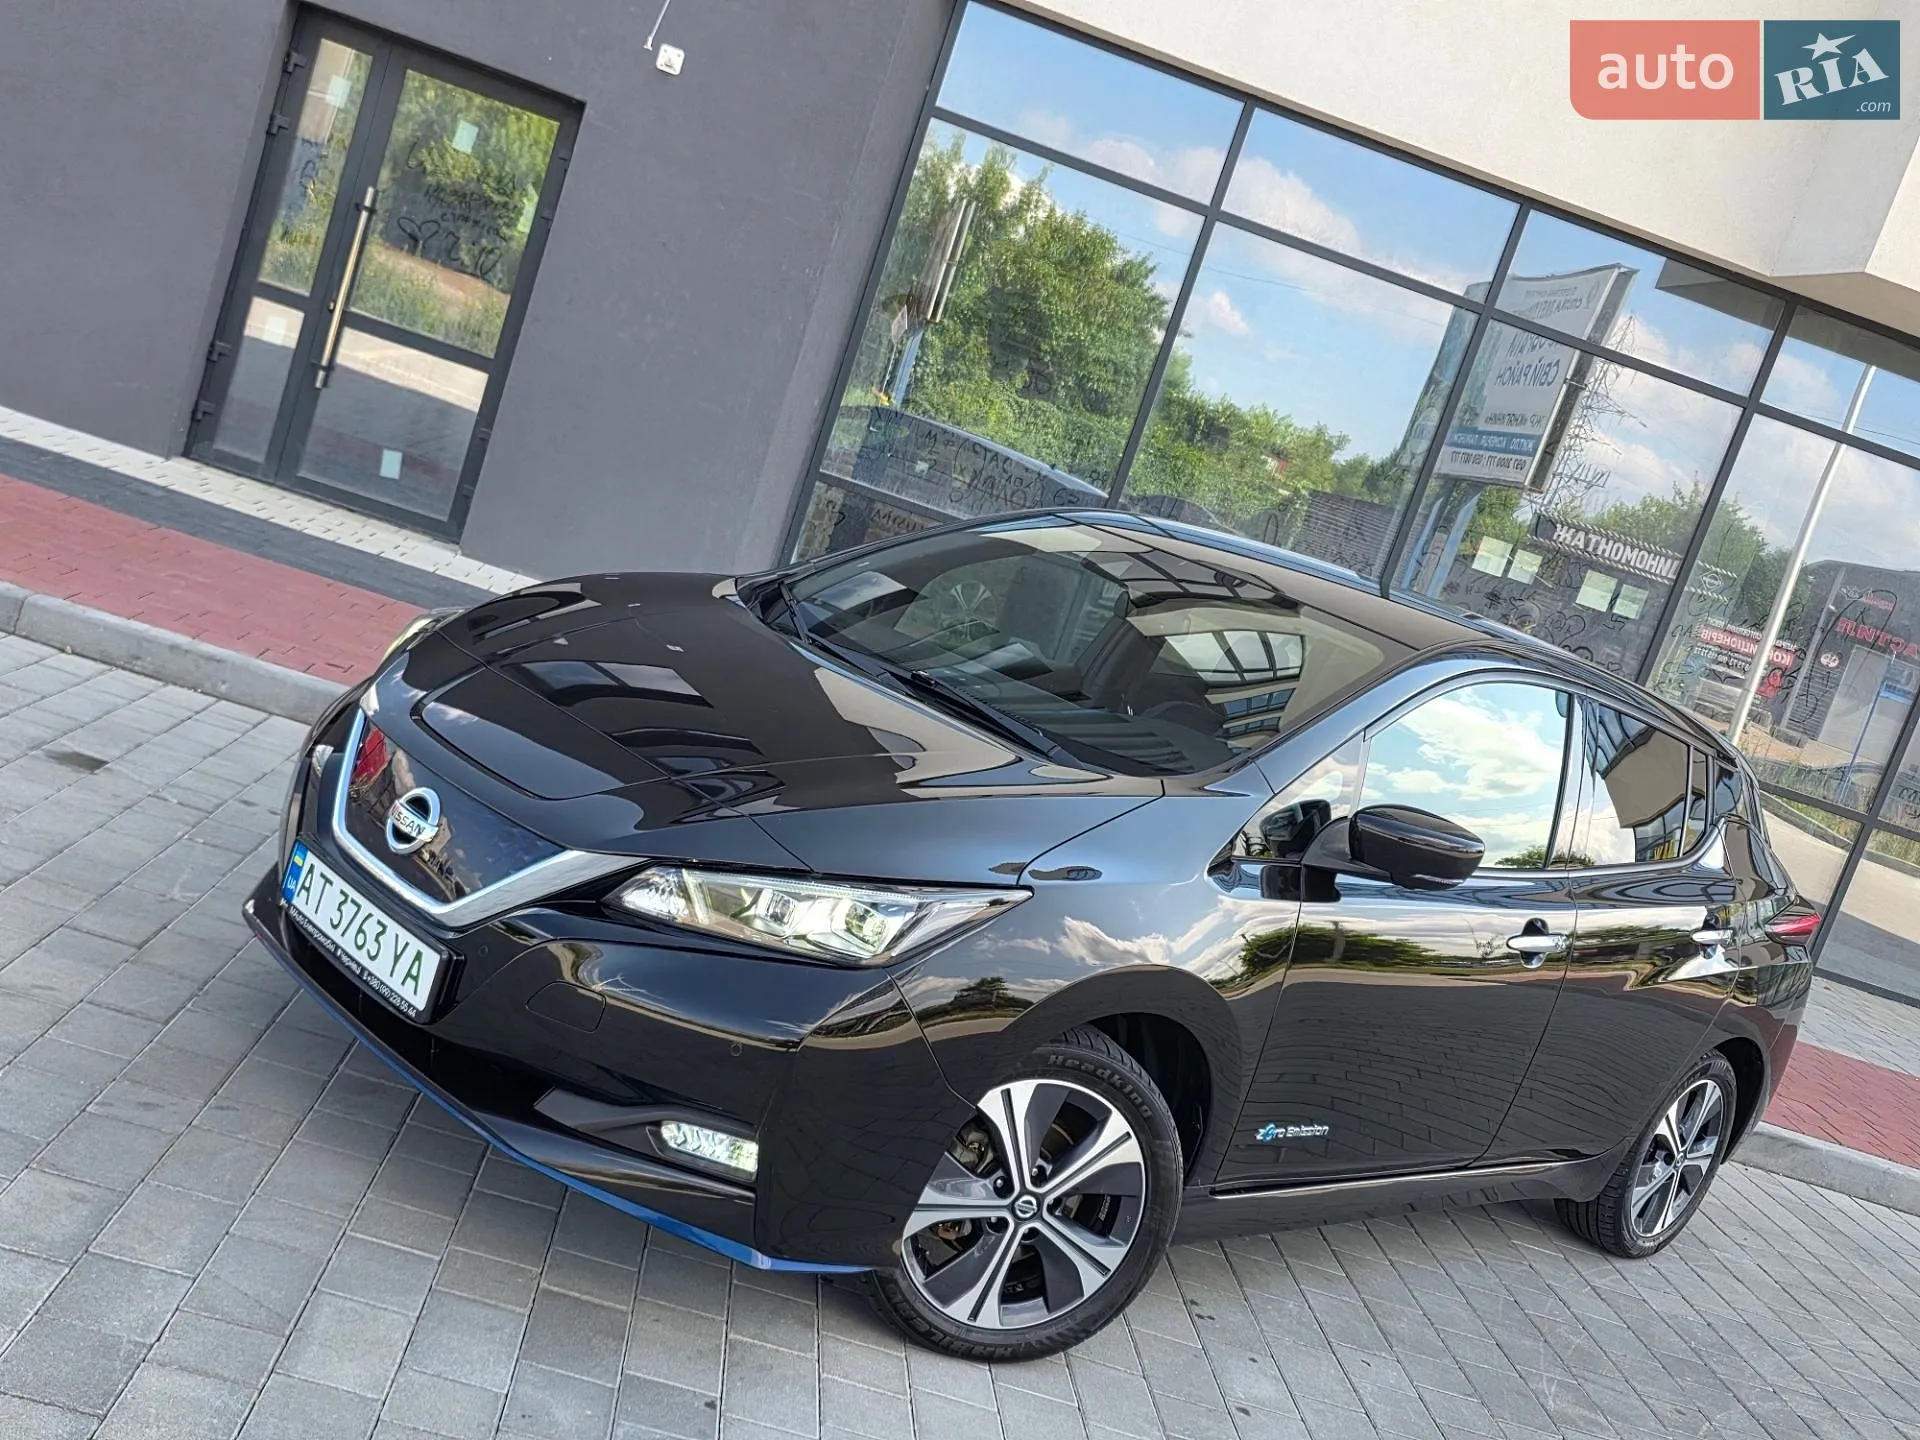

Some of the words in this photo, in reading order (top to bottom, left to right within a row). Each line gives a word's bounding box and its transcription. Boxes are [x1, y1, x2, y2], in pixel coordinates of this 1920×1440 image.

[296, 863, 333, 915] AT
[329, 889, 389, 962] 3763
[389, 933, 424, 997] YA
[1047, 1054, 1153, 1118] Headking
